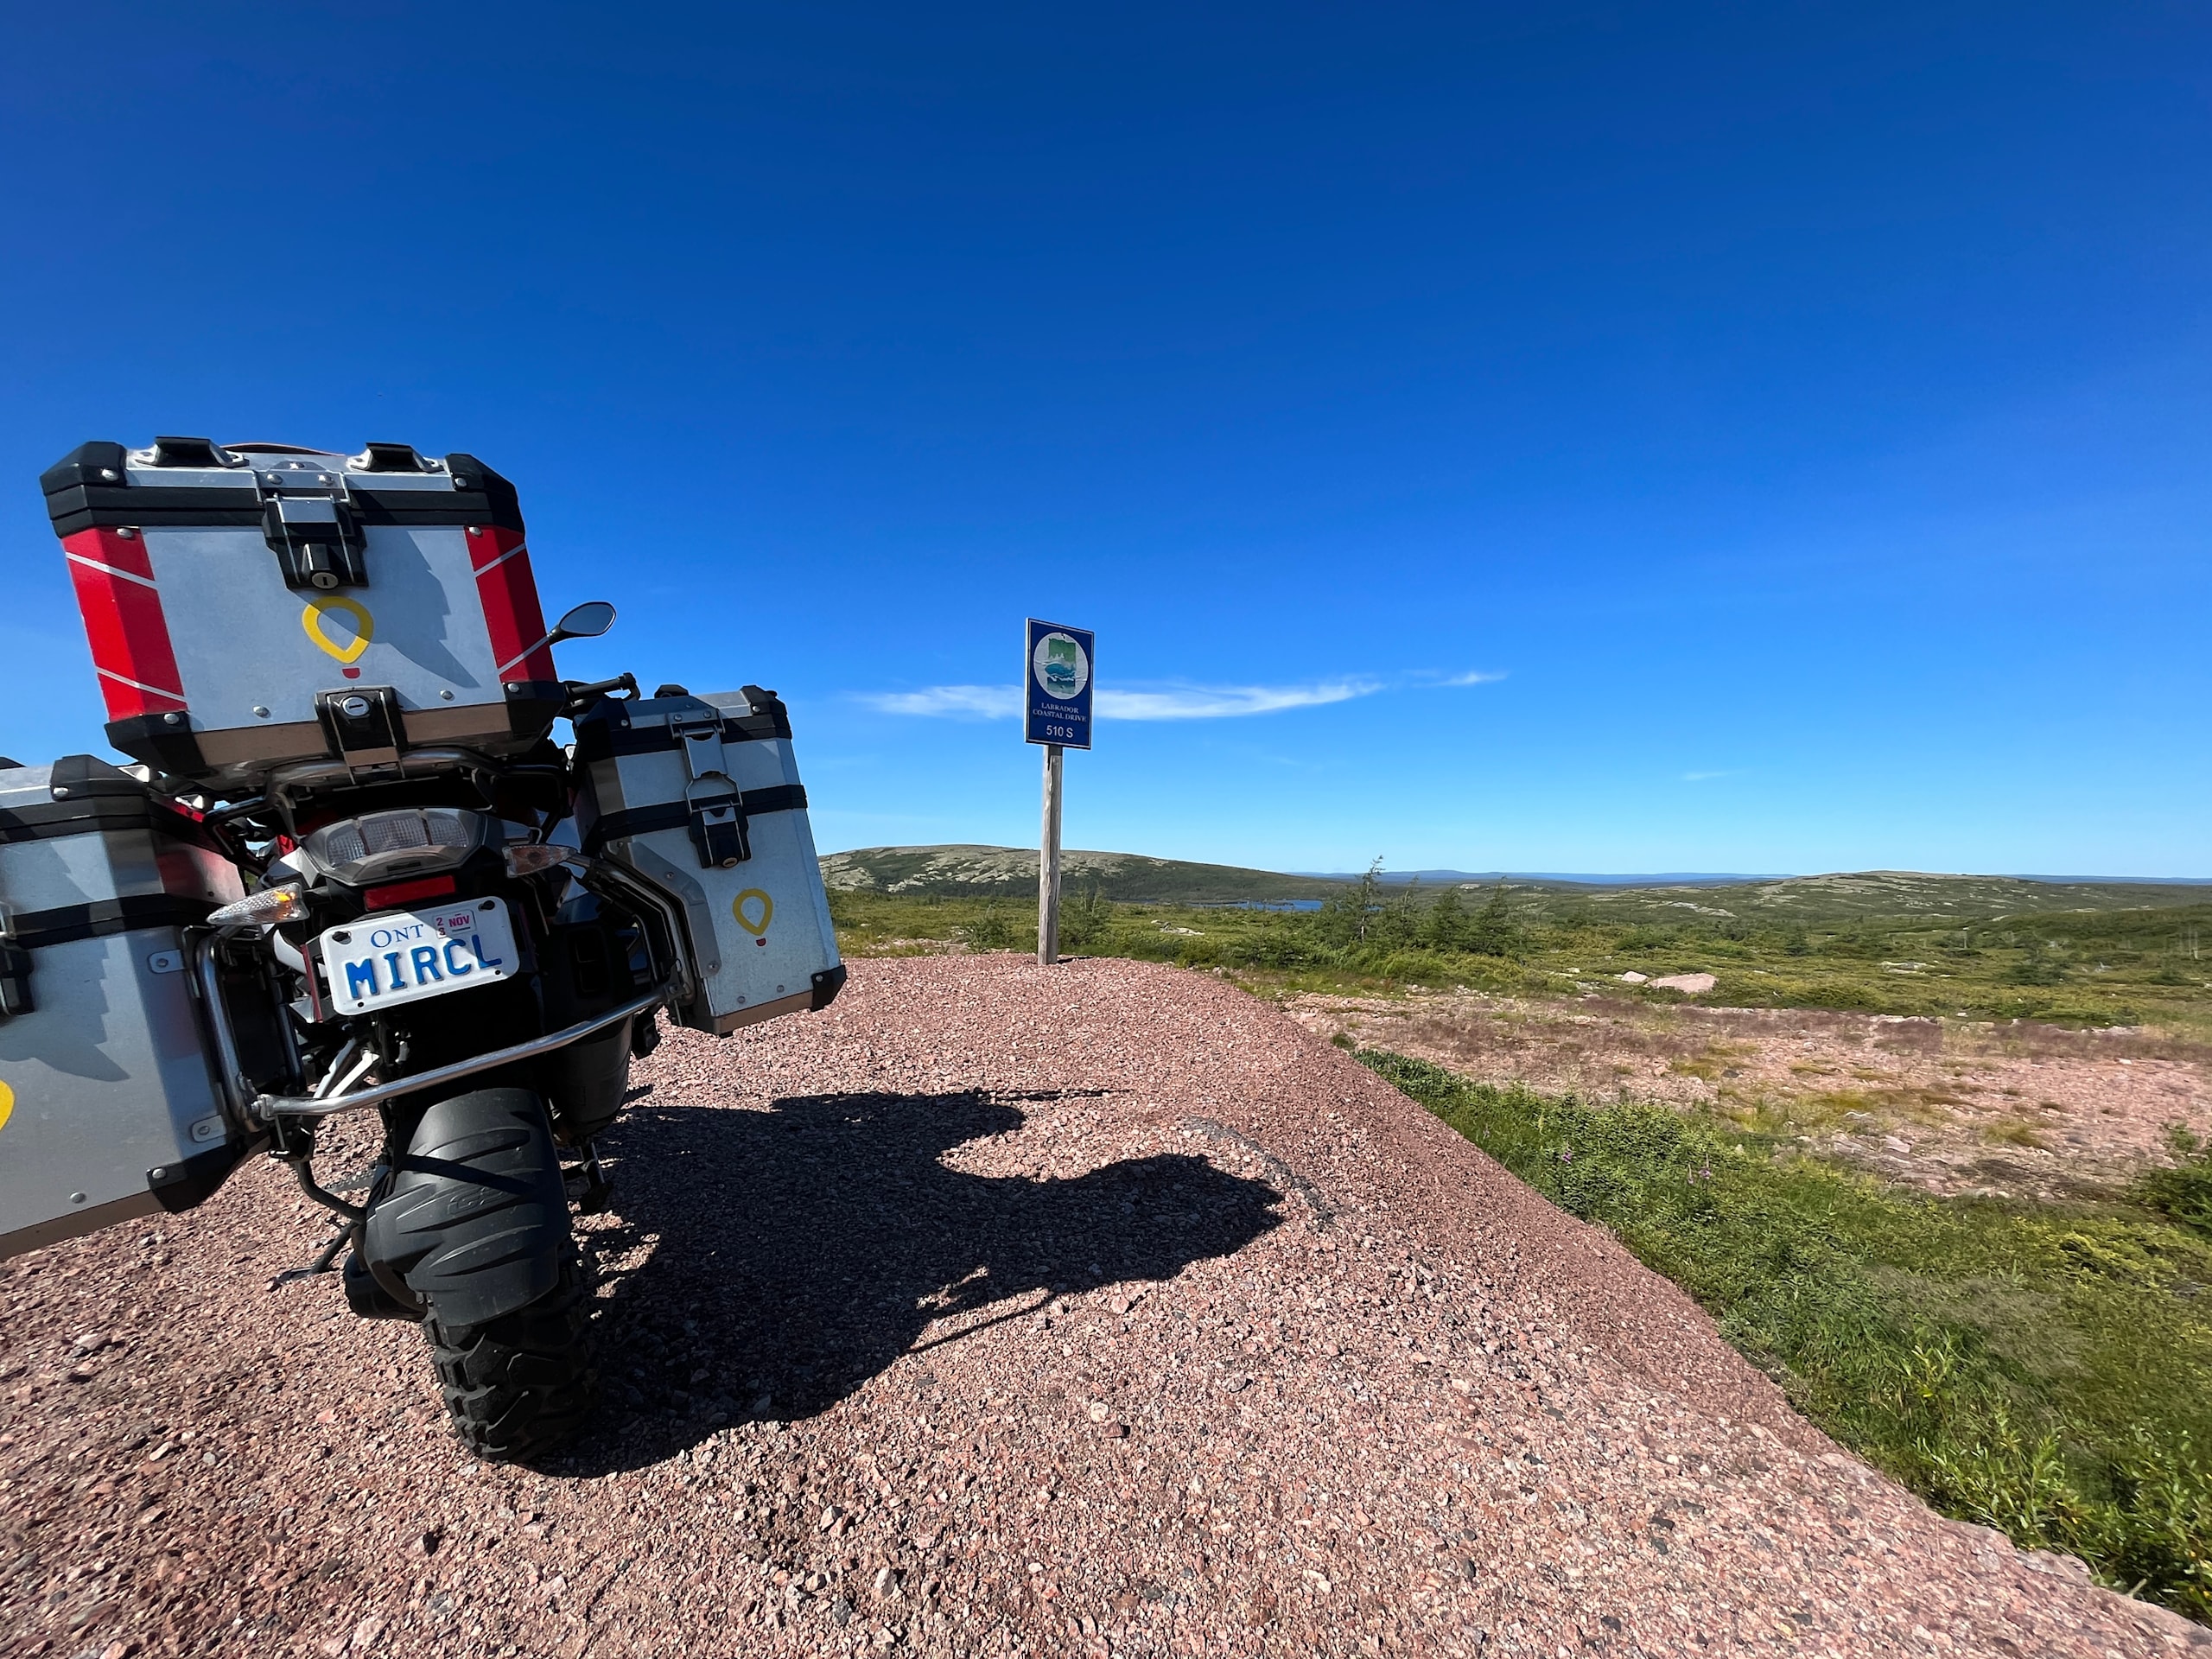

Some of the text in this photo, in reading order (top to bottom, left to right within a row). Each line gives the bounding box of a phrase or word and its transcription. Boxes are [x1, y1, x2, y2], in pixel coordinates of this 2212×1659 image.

[1041, 702, 1079, 714] LABRADOR
[1033, 709, 1087, 722] COASTAL DRIVE
[1046, 725, 1073, 738] 510 S
[448, 915, 470, 927] NOV
[345, 933, 503, 1001] MIRCL
